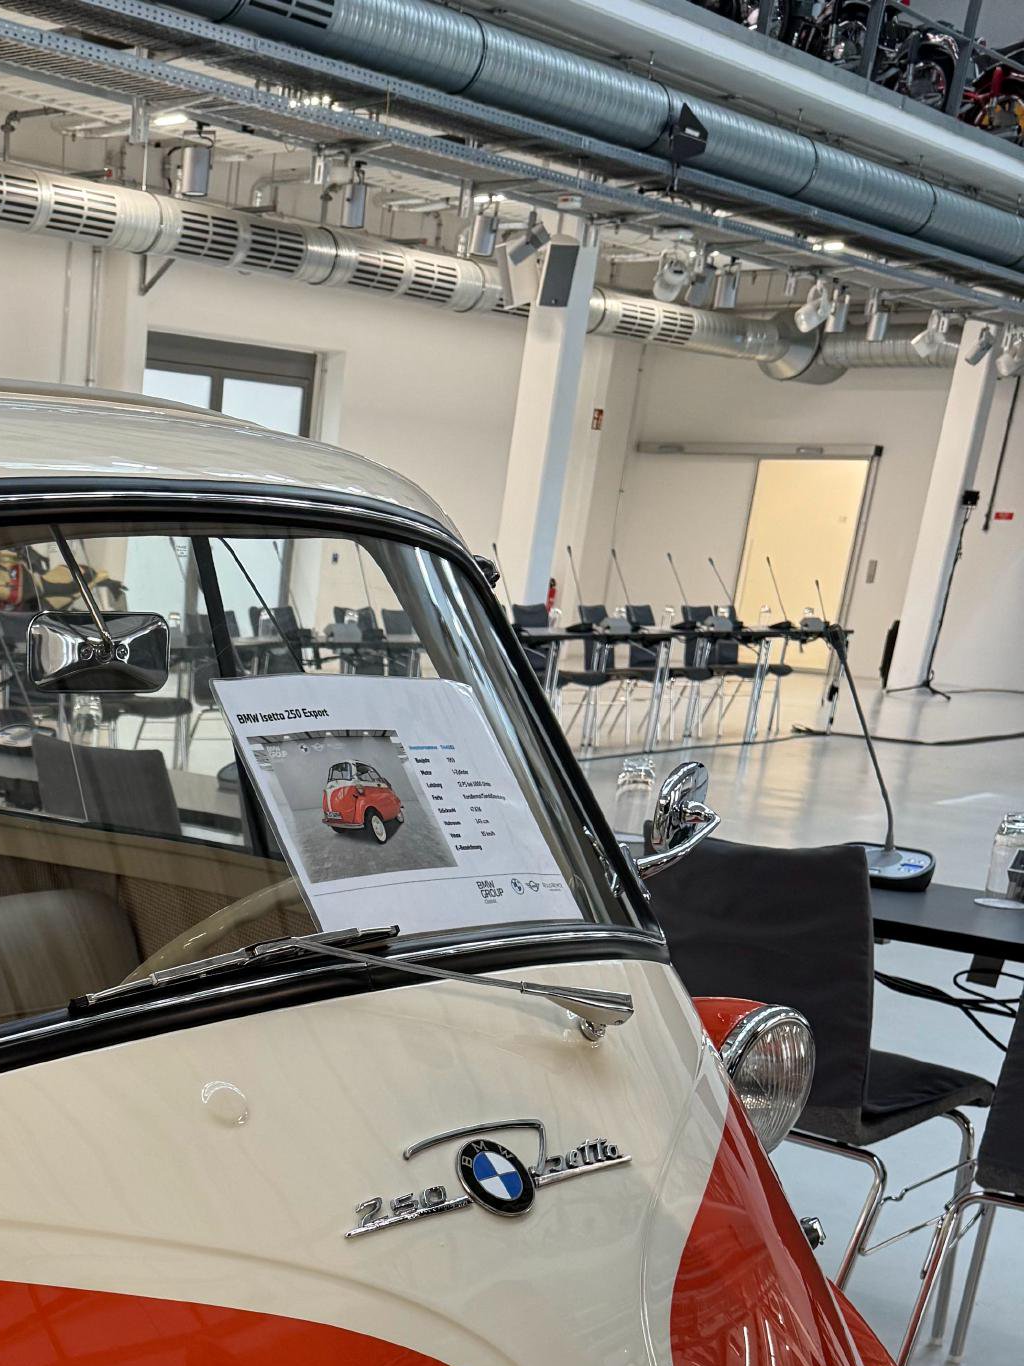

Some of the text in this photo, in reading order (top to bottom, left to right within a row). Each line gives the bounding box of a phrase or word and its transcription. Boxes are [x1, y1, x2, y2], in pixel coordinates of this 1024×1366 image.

[236, 708, 330, 724] BMW Isetta 250 Export
[476, 880, 495, 889] BMW
[480, 888, 504, 898] GROUP
[462, 1141, 513, 1168] BMW
[355, 1186, 448, 1228] 250
